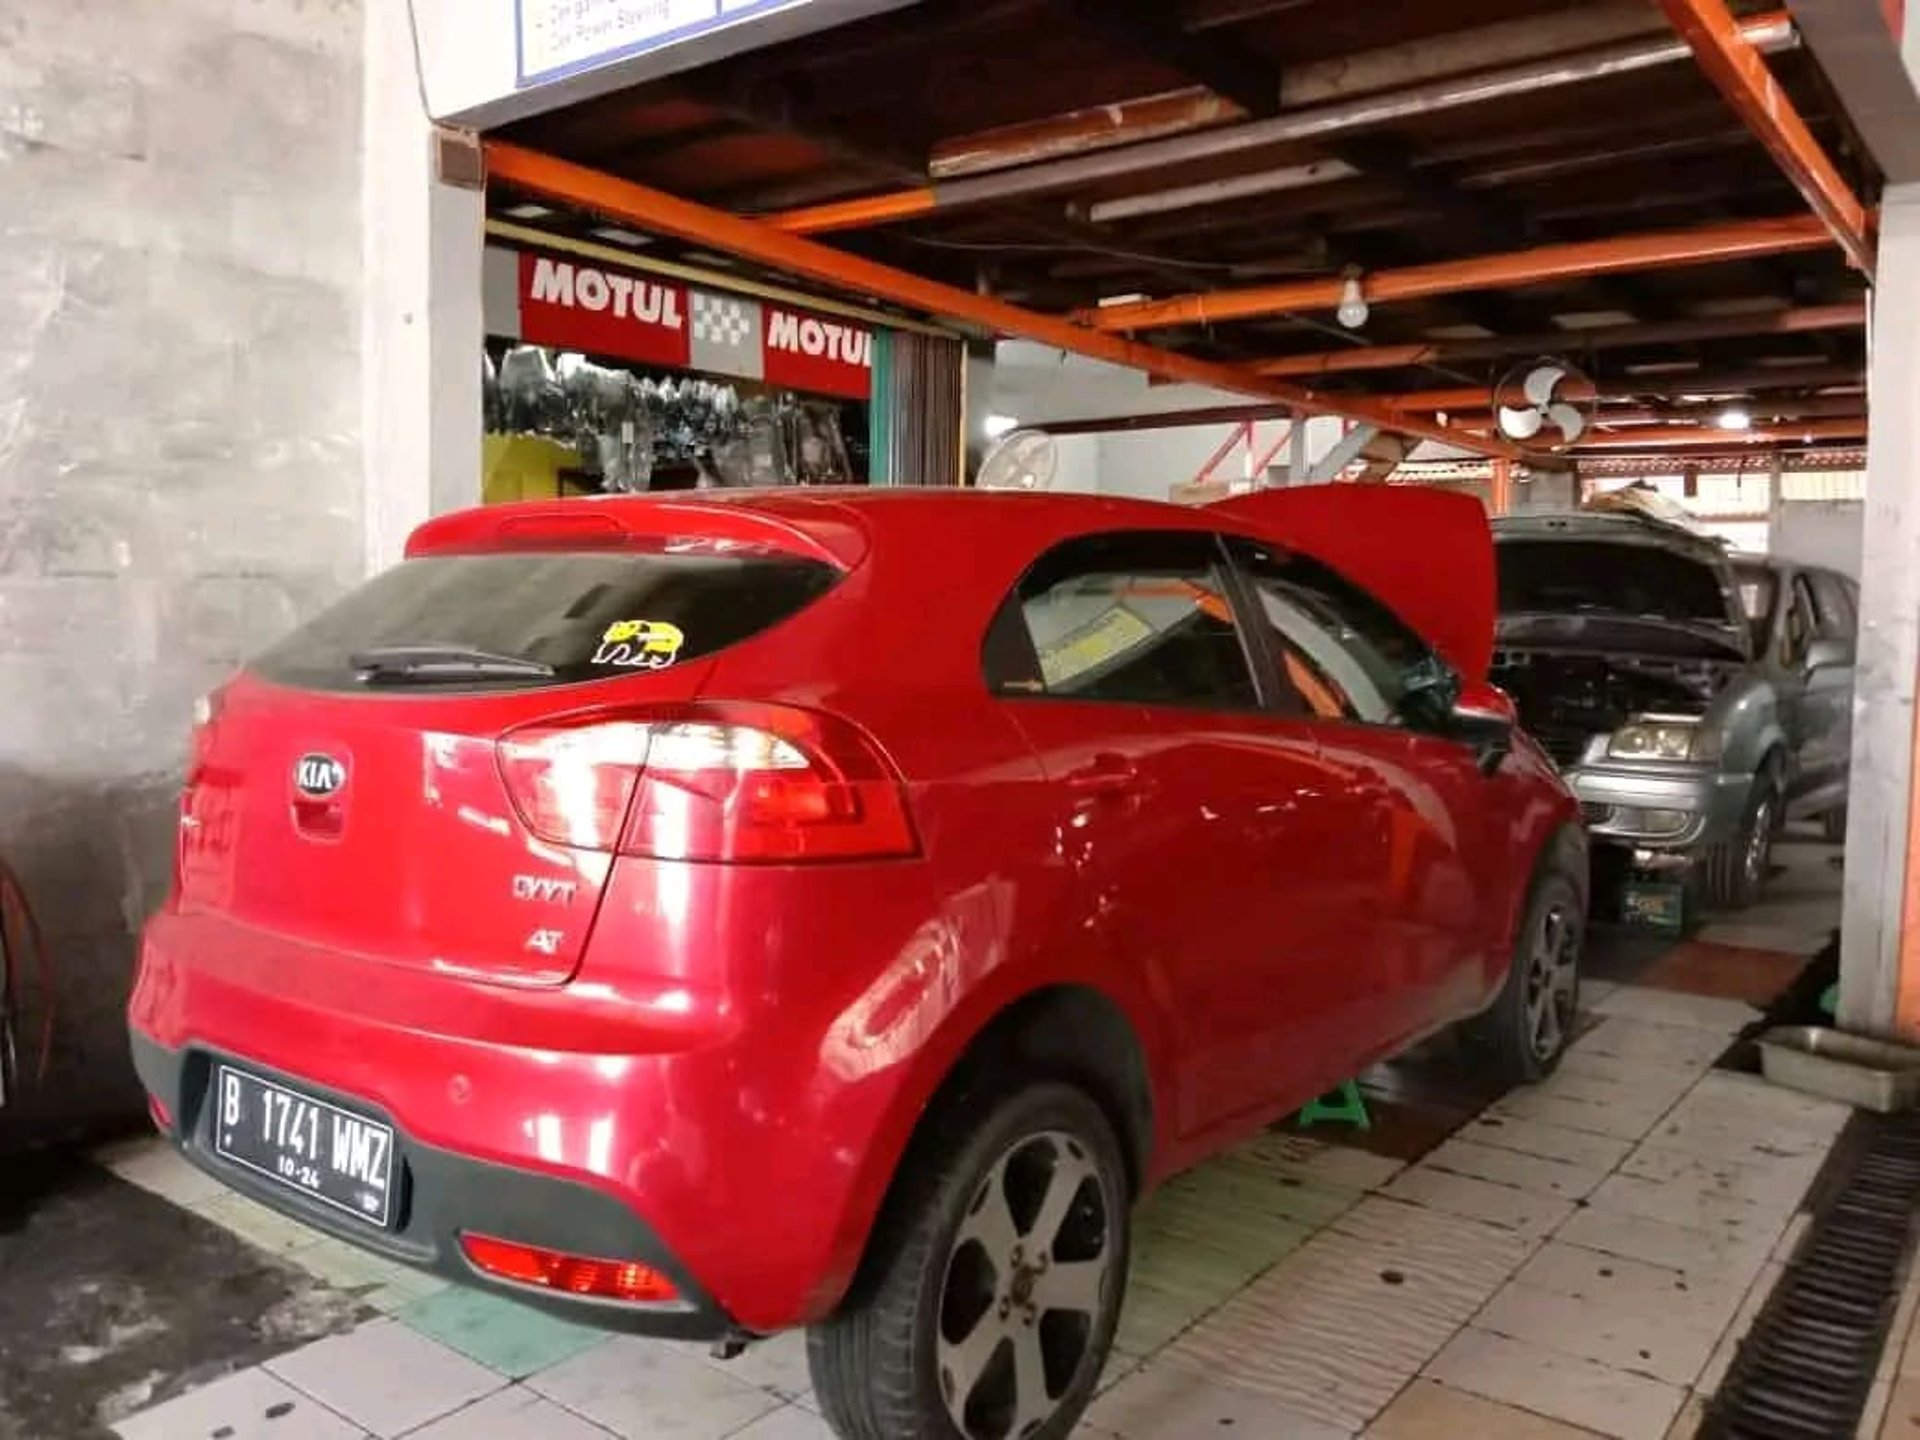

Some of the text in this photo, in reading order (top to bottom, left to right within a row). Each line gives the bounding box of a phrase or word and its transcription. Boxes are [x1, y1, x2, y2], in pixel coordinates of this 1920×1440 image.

[531, 257, 682, 329] MOTUL
[298, 760, 333, 790] KIA
[526, 928, 565, 955] AT
[224, 1074, 388, 1190] B 1741 WMZ
